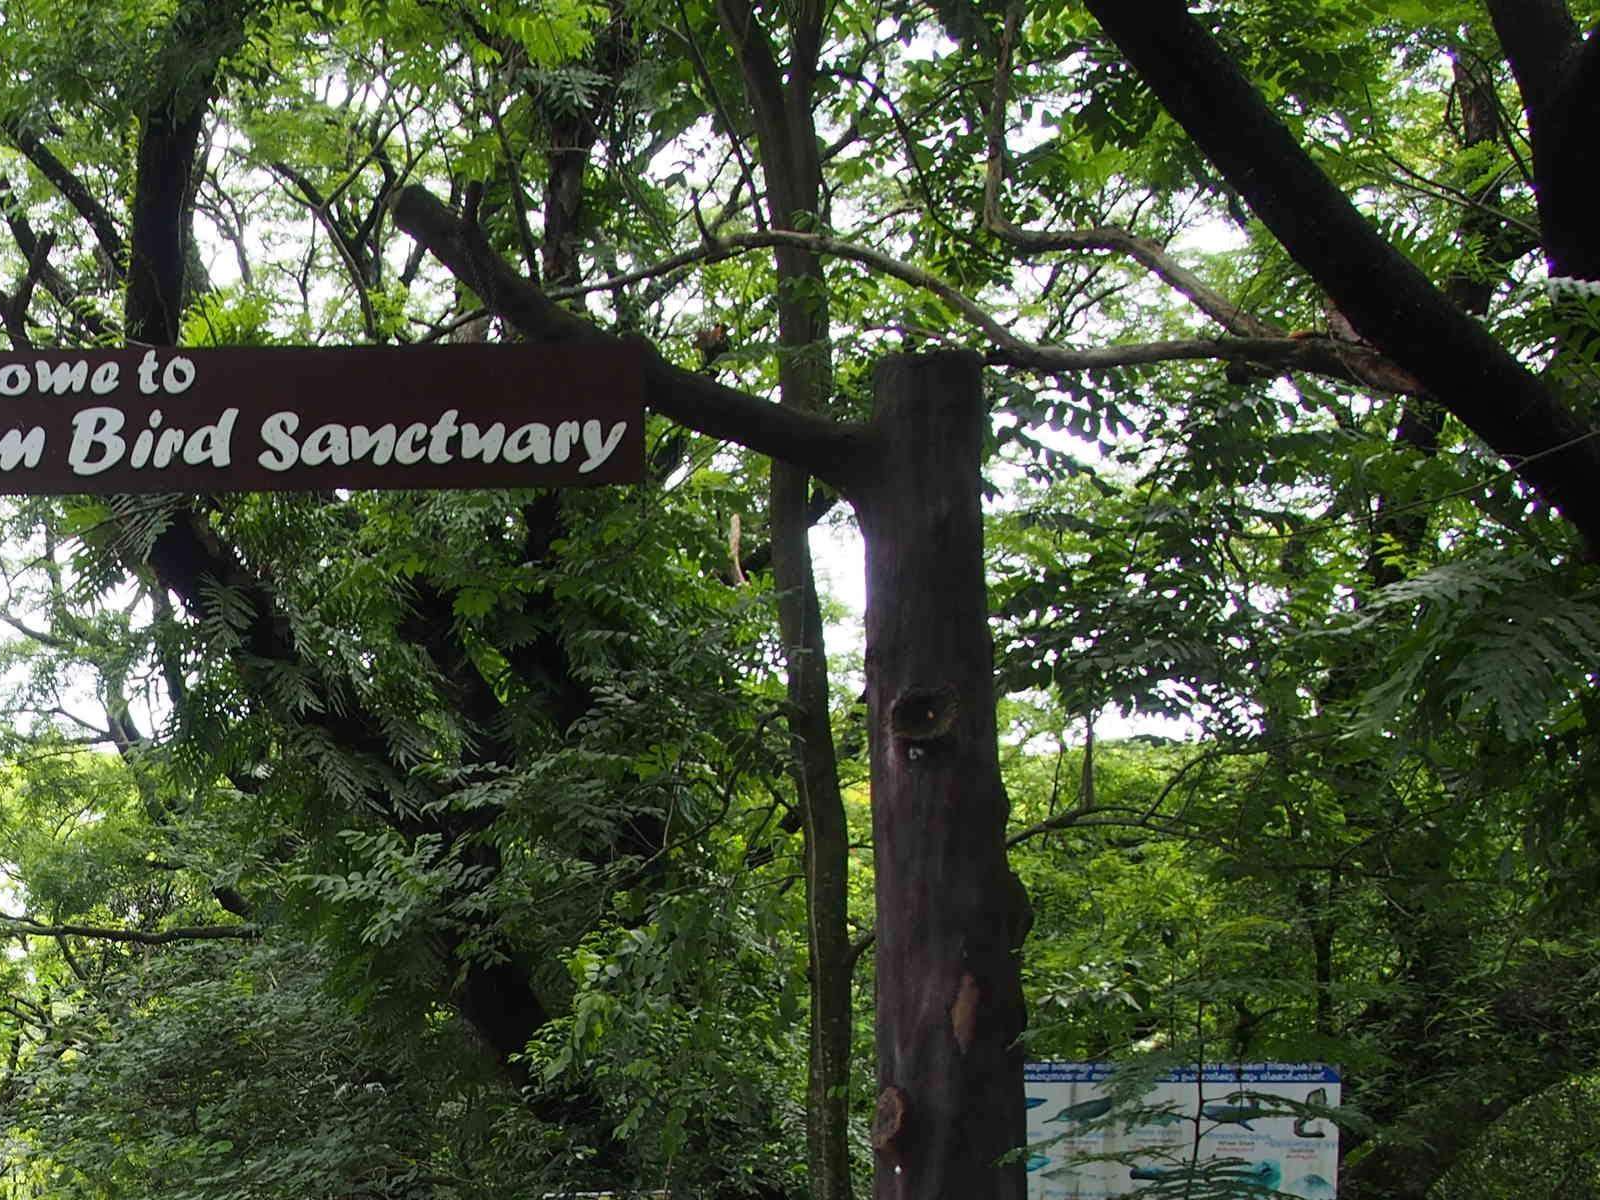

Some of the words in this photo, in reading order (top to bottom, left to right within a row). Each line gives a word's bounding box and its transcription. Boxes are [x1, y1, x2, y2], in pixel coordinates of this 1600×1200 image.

[138, 350, 196, 393] to
[68, 407, 239, 475] Bird
[258, 409, 627, 473] Sanctuary
